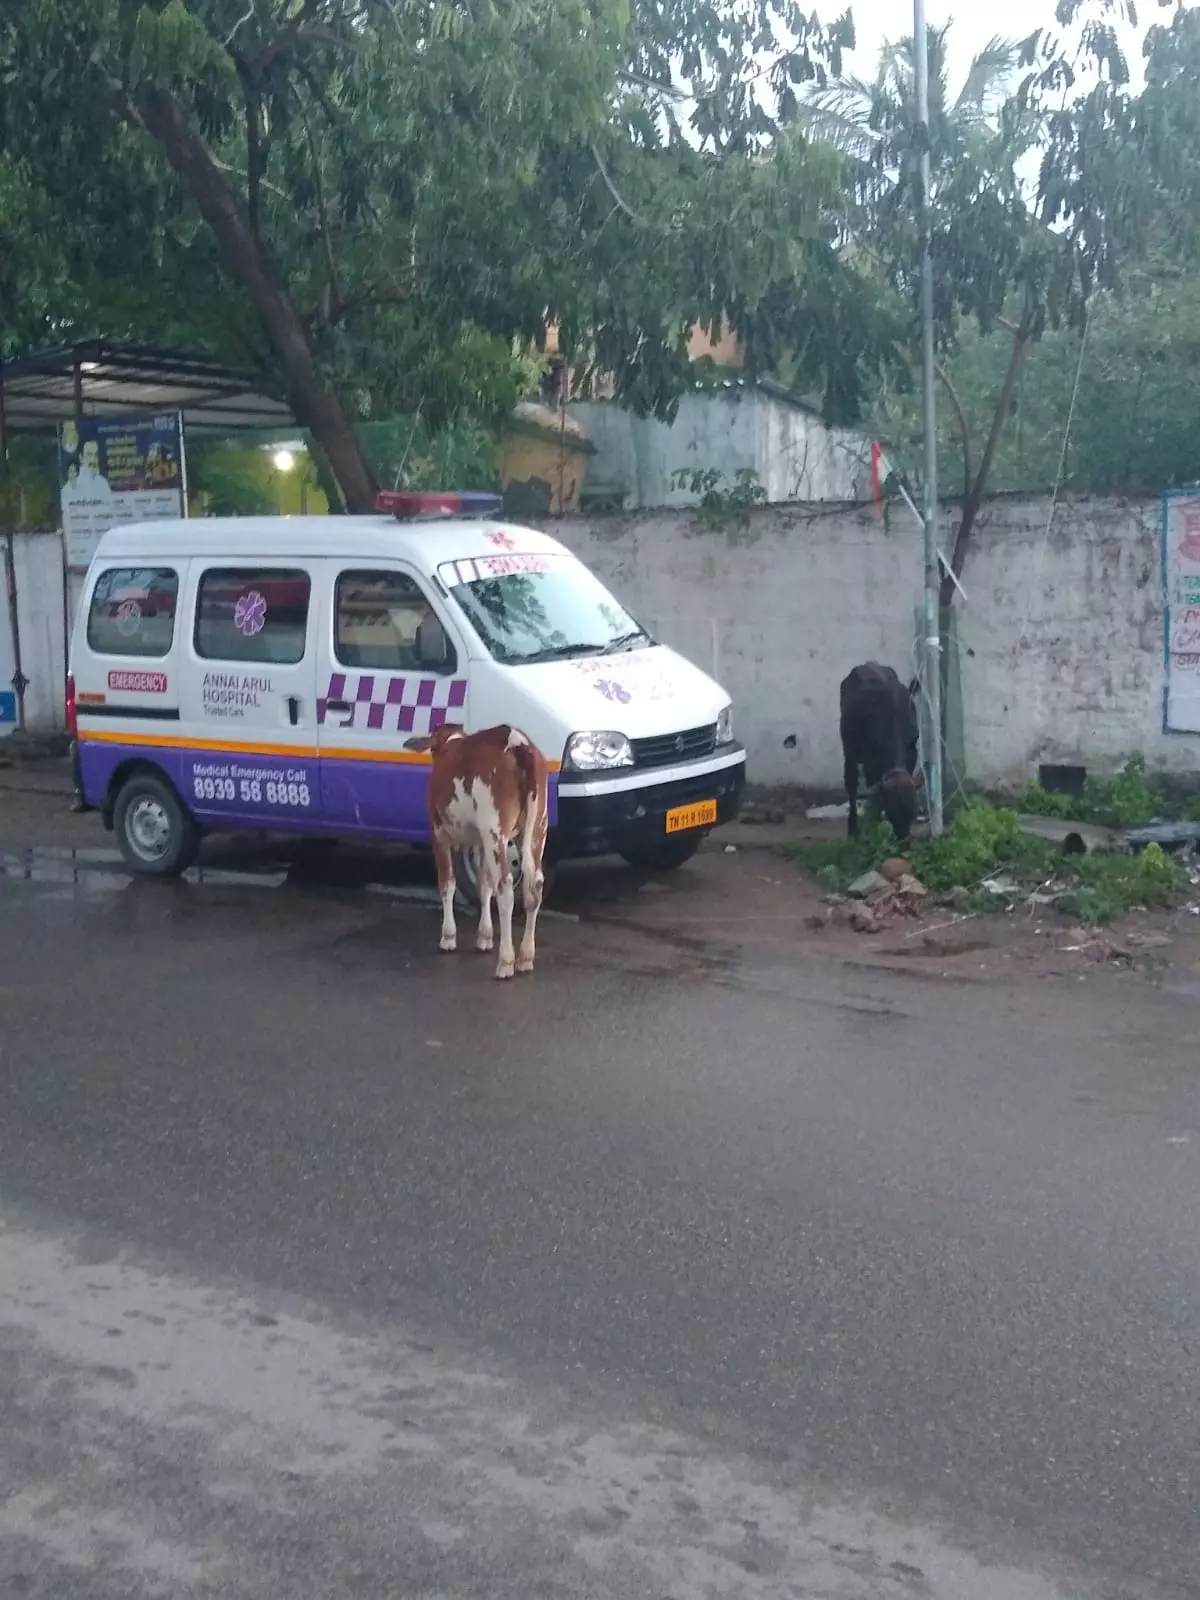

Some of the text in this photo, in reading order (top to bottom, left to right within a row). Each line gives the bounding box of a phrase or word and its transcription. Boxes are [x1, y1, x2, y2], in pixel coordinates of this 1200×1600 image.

[109, 673, 165, 692] EMERGENCY
[203, 672, 275, 692] ANNAI ARUL
[203, 688, 260, 707] HOSPITAL
[193, 763, 306, 783] Medical Emergency Call
[194, 777, 310, 806] 8939 58 8888
[669, 815, 679, 829] TN
